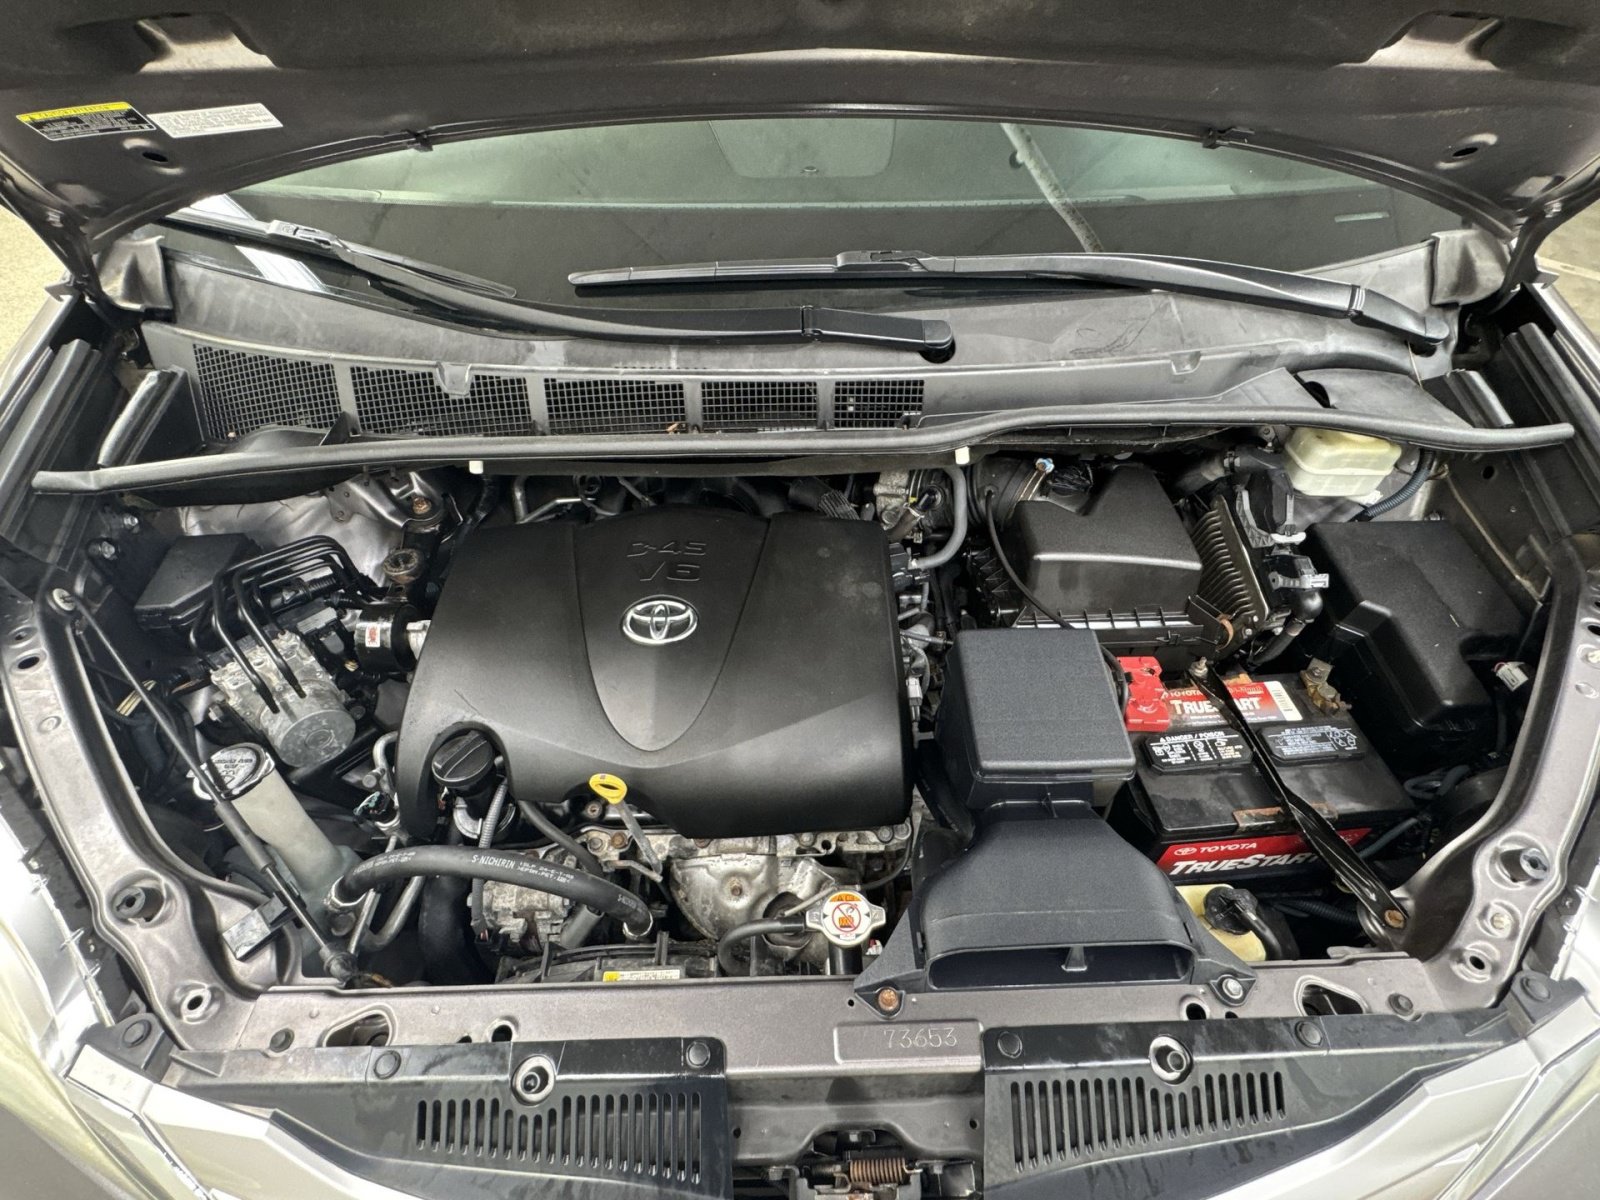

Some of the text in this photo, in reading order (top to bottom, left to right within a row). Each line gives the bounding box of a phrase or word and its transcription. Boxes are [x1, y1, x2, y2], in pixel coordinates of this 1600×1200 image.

[626, 541, 707, 558] D-4S
[638, 561, 701, 582] V6
[1170, 689, 1204, 698] TOYOTA
[1169, 698, 1262, 715] TRUERT
[1166, 733, 1194, 742] DANGER
[1200, 843, 1257, 853] TOYOTA
[471, 854, 516, 869] S-NICHIRIN
[883, 1027, 957, 1049] 73653
